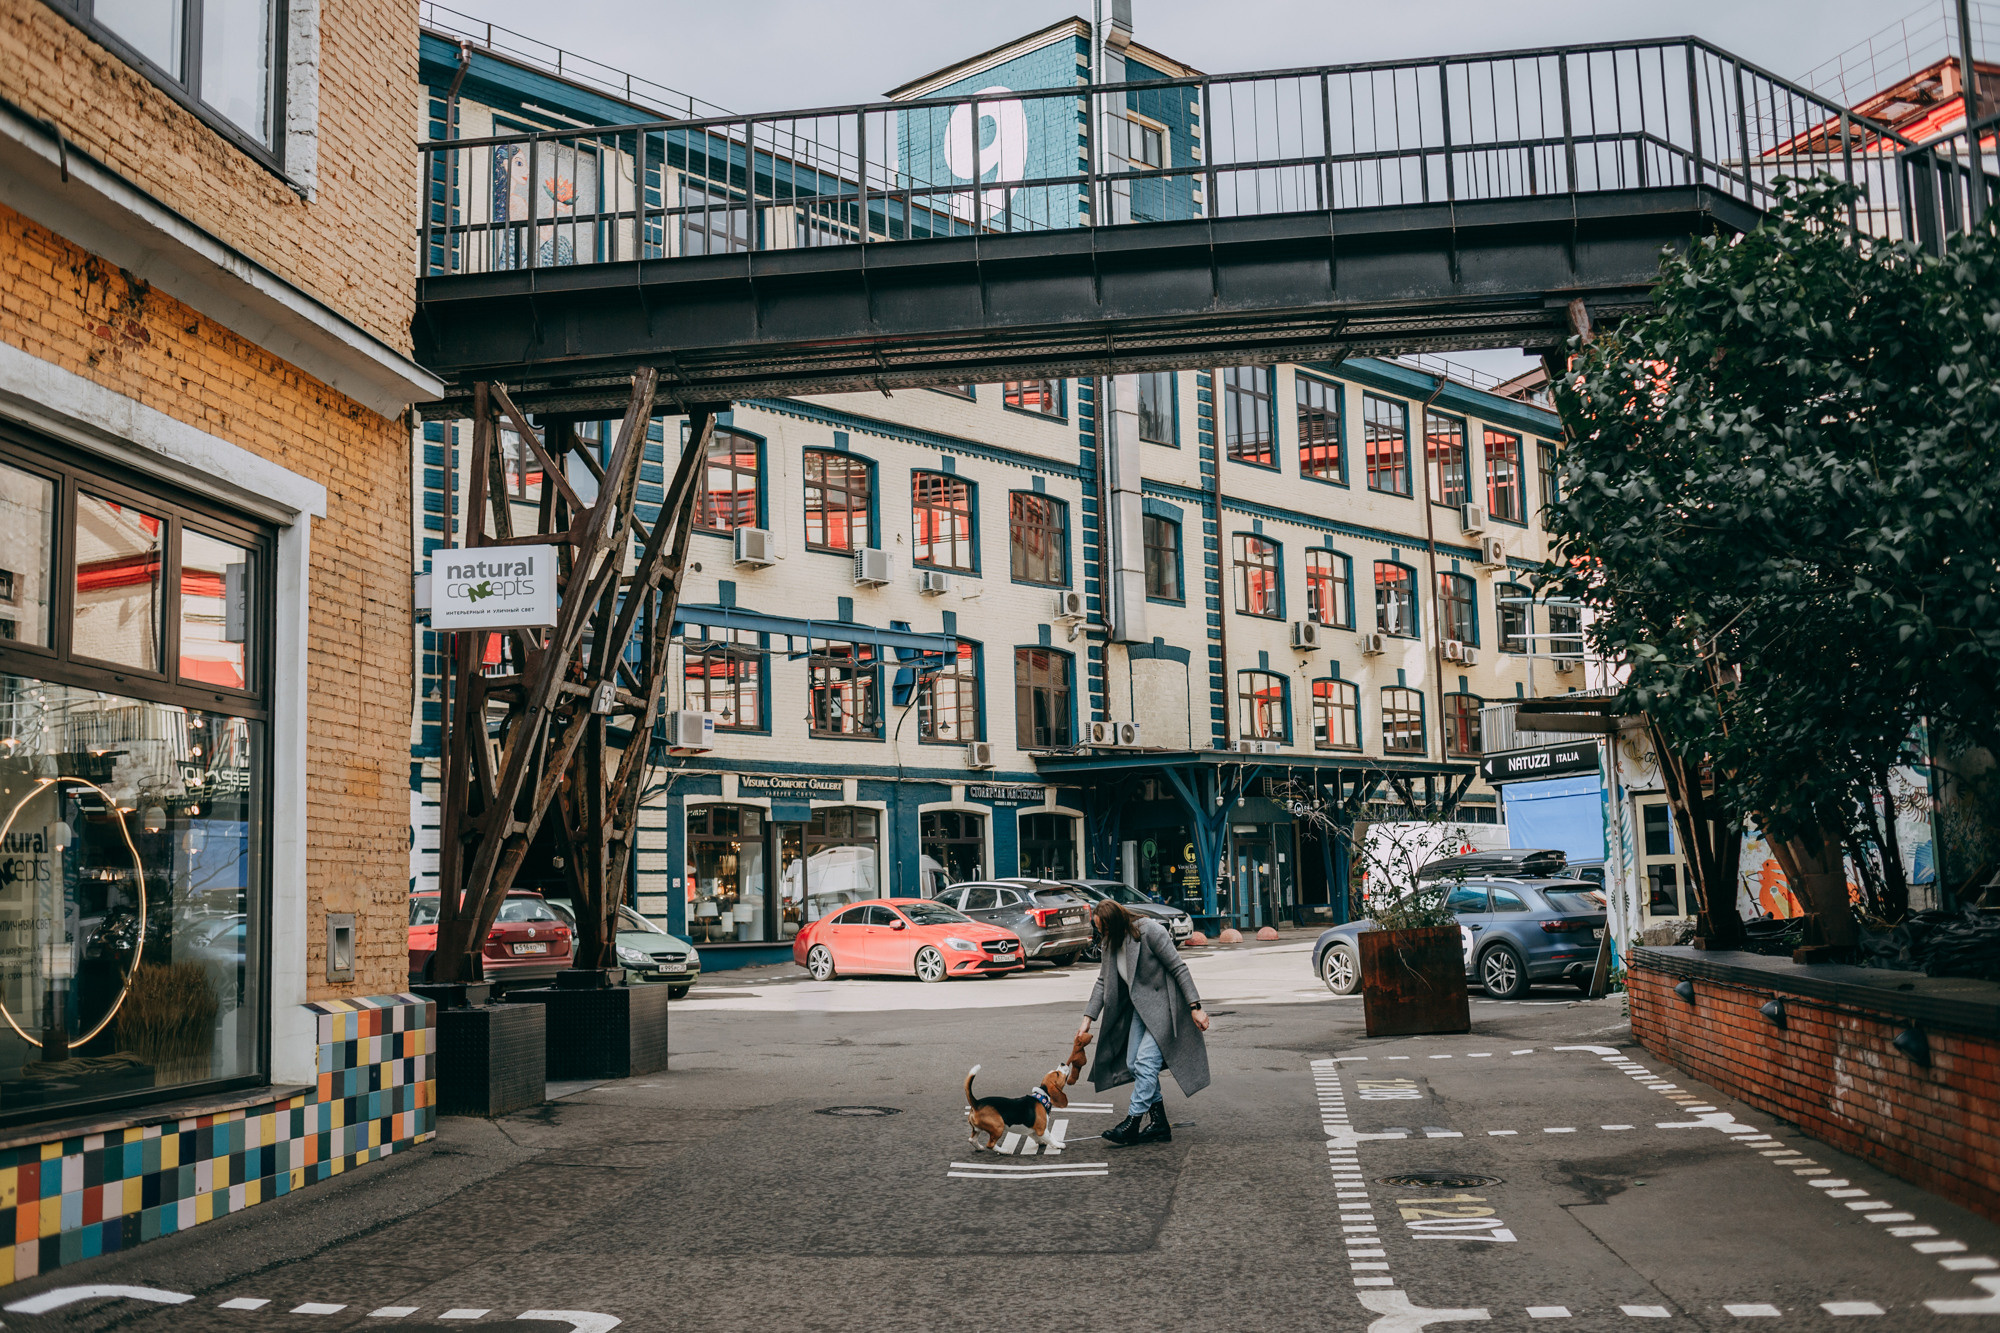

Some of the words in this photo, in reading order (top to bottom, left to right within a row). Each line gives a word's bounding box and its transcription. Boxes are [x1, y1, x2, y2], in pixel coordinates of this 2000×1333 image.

[944, 86, 1028, 222] 9
[447, 556, 534, 579] natural
[1508, 753, 1551, 772] NATUZZI
[1556, 751, 1580, 763] ITALIA
[36, 918, 52, 930] СВЕТ
